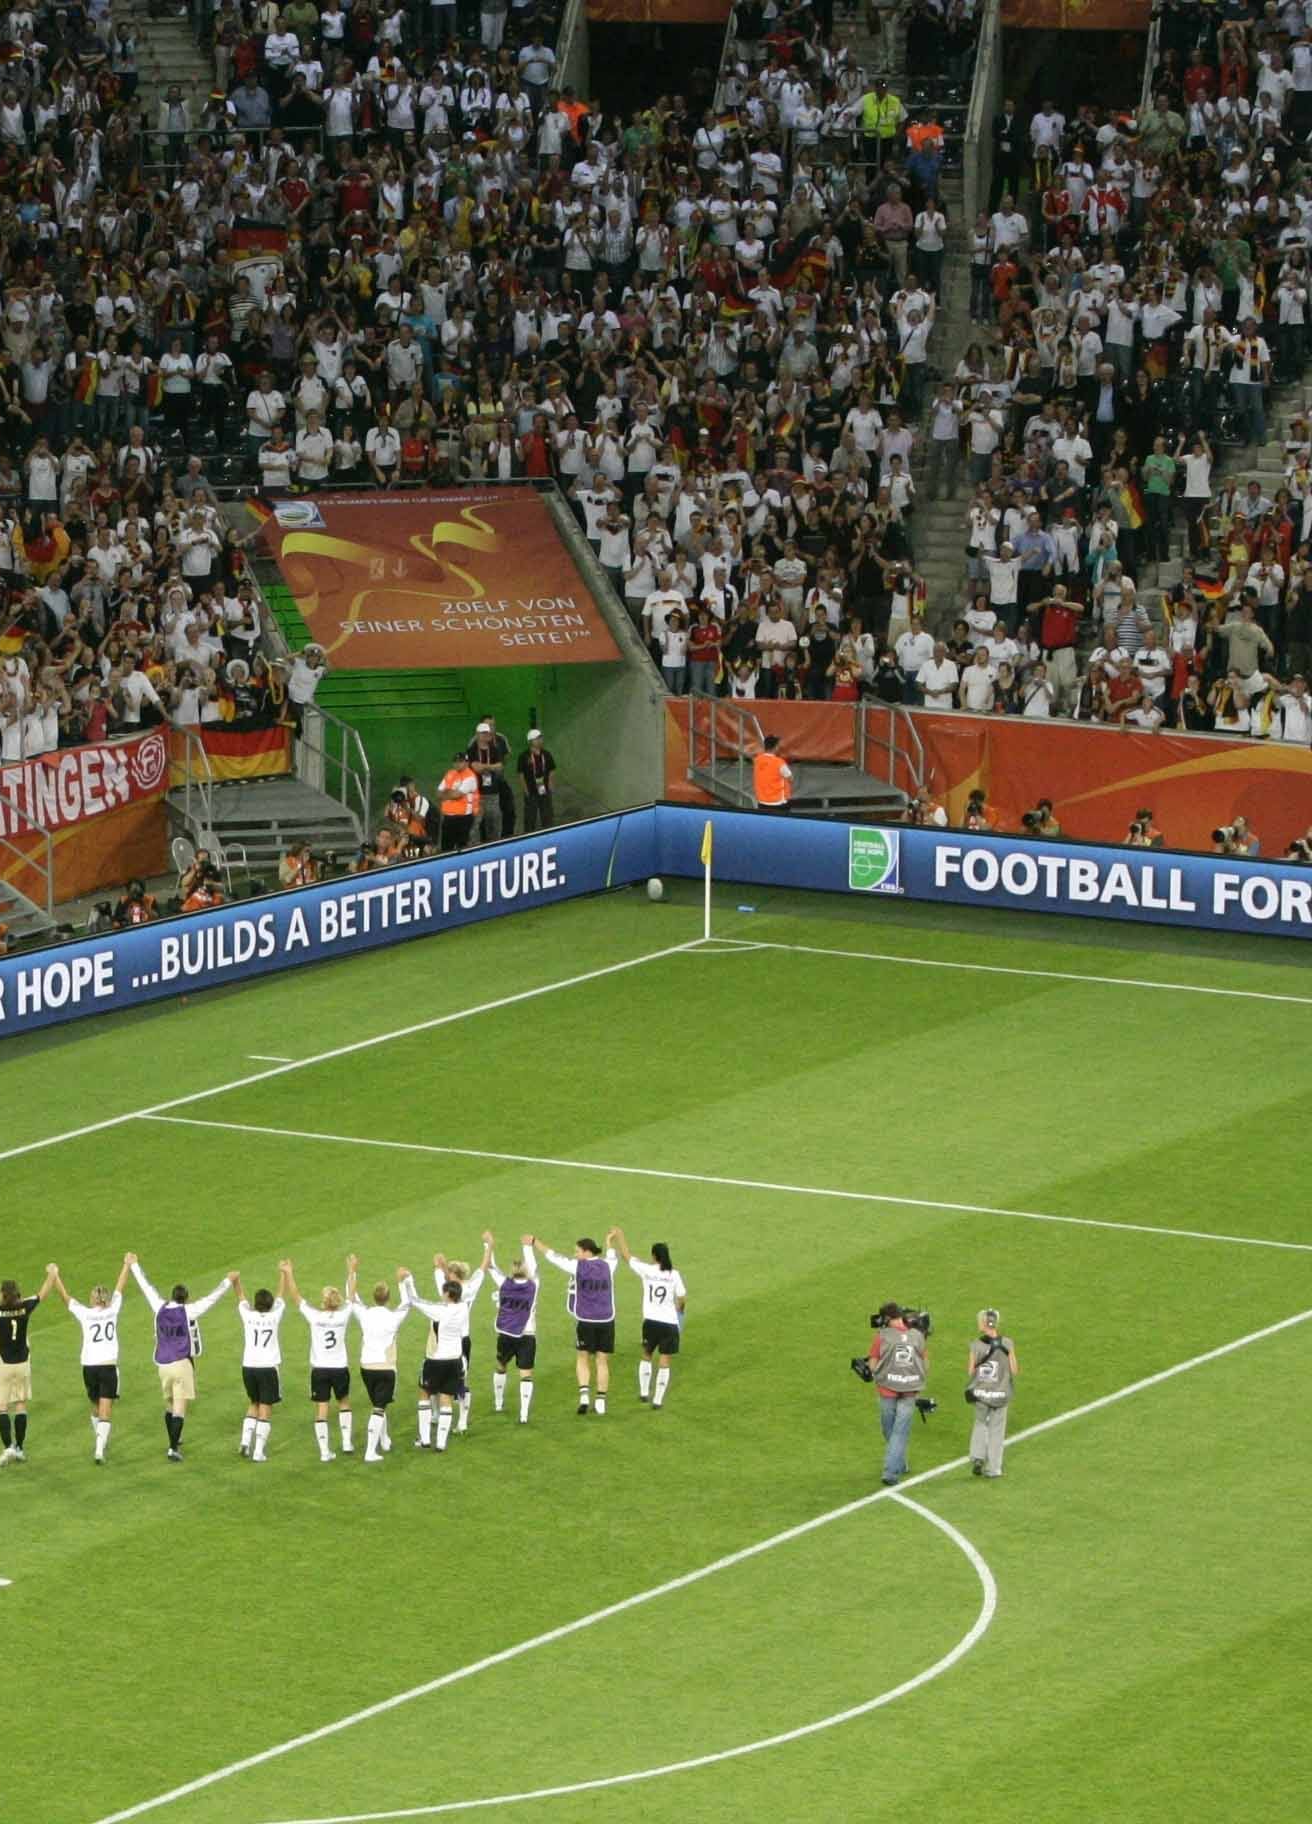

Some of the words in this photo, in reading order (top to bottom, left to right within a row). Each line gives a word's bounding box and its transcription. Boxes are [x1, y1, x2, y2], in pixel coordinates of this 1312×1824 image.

[440, 600, 510, 614] 20ELF
[518, 597, 576, 611] VON
[339, 619, 425, 633] SEINER
[934, 845, 1196, 912] FOOTBALL
[1213, 872, 1312, 924] FOR
[17, 951, 114, 1016] HOPE
[285, 907, 310, 951] A
[320, 878, 432, 942] BETTER
[442, 847, 567, 913] FUTURE.
[649, 1285, 667, 1304] 19
[11, 1319, 18, 1341] 1
[90, 1321, 115, 1343] 20
[253, 1329, 273, 1348] 17
[324, 1331, 337, 1350] 3
